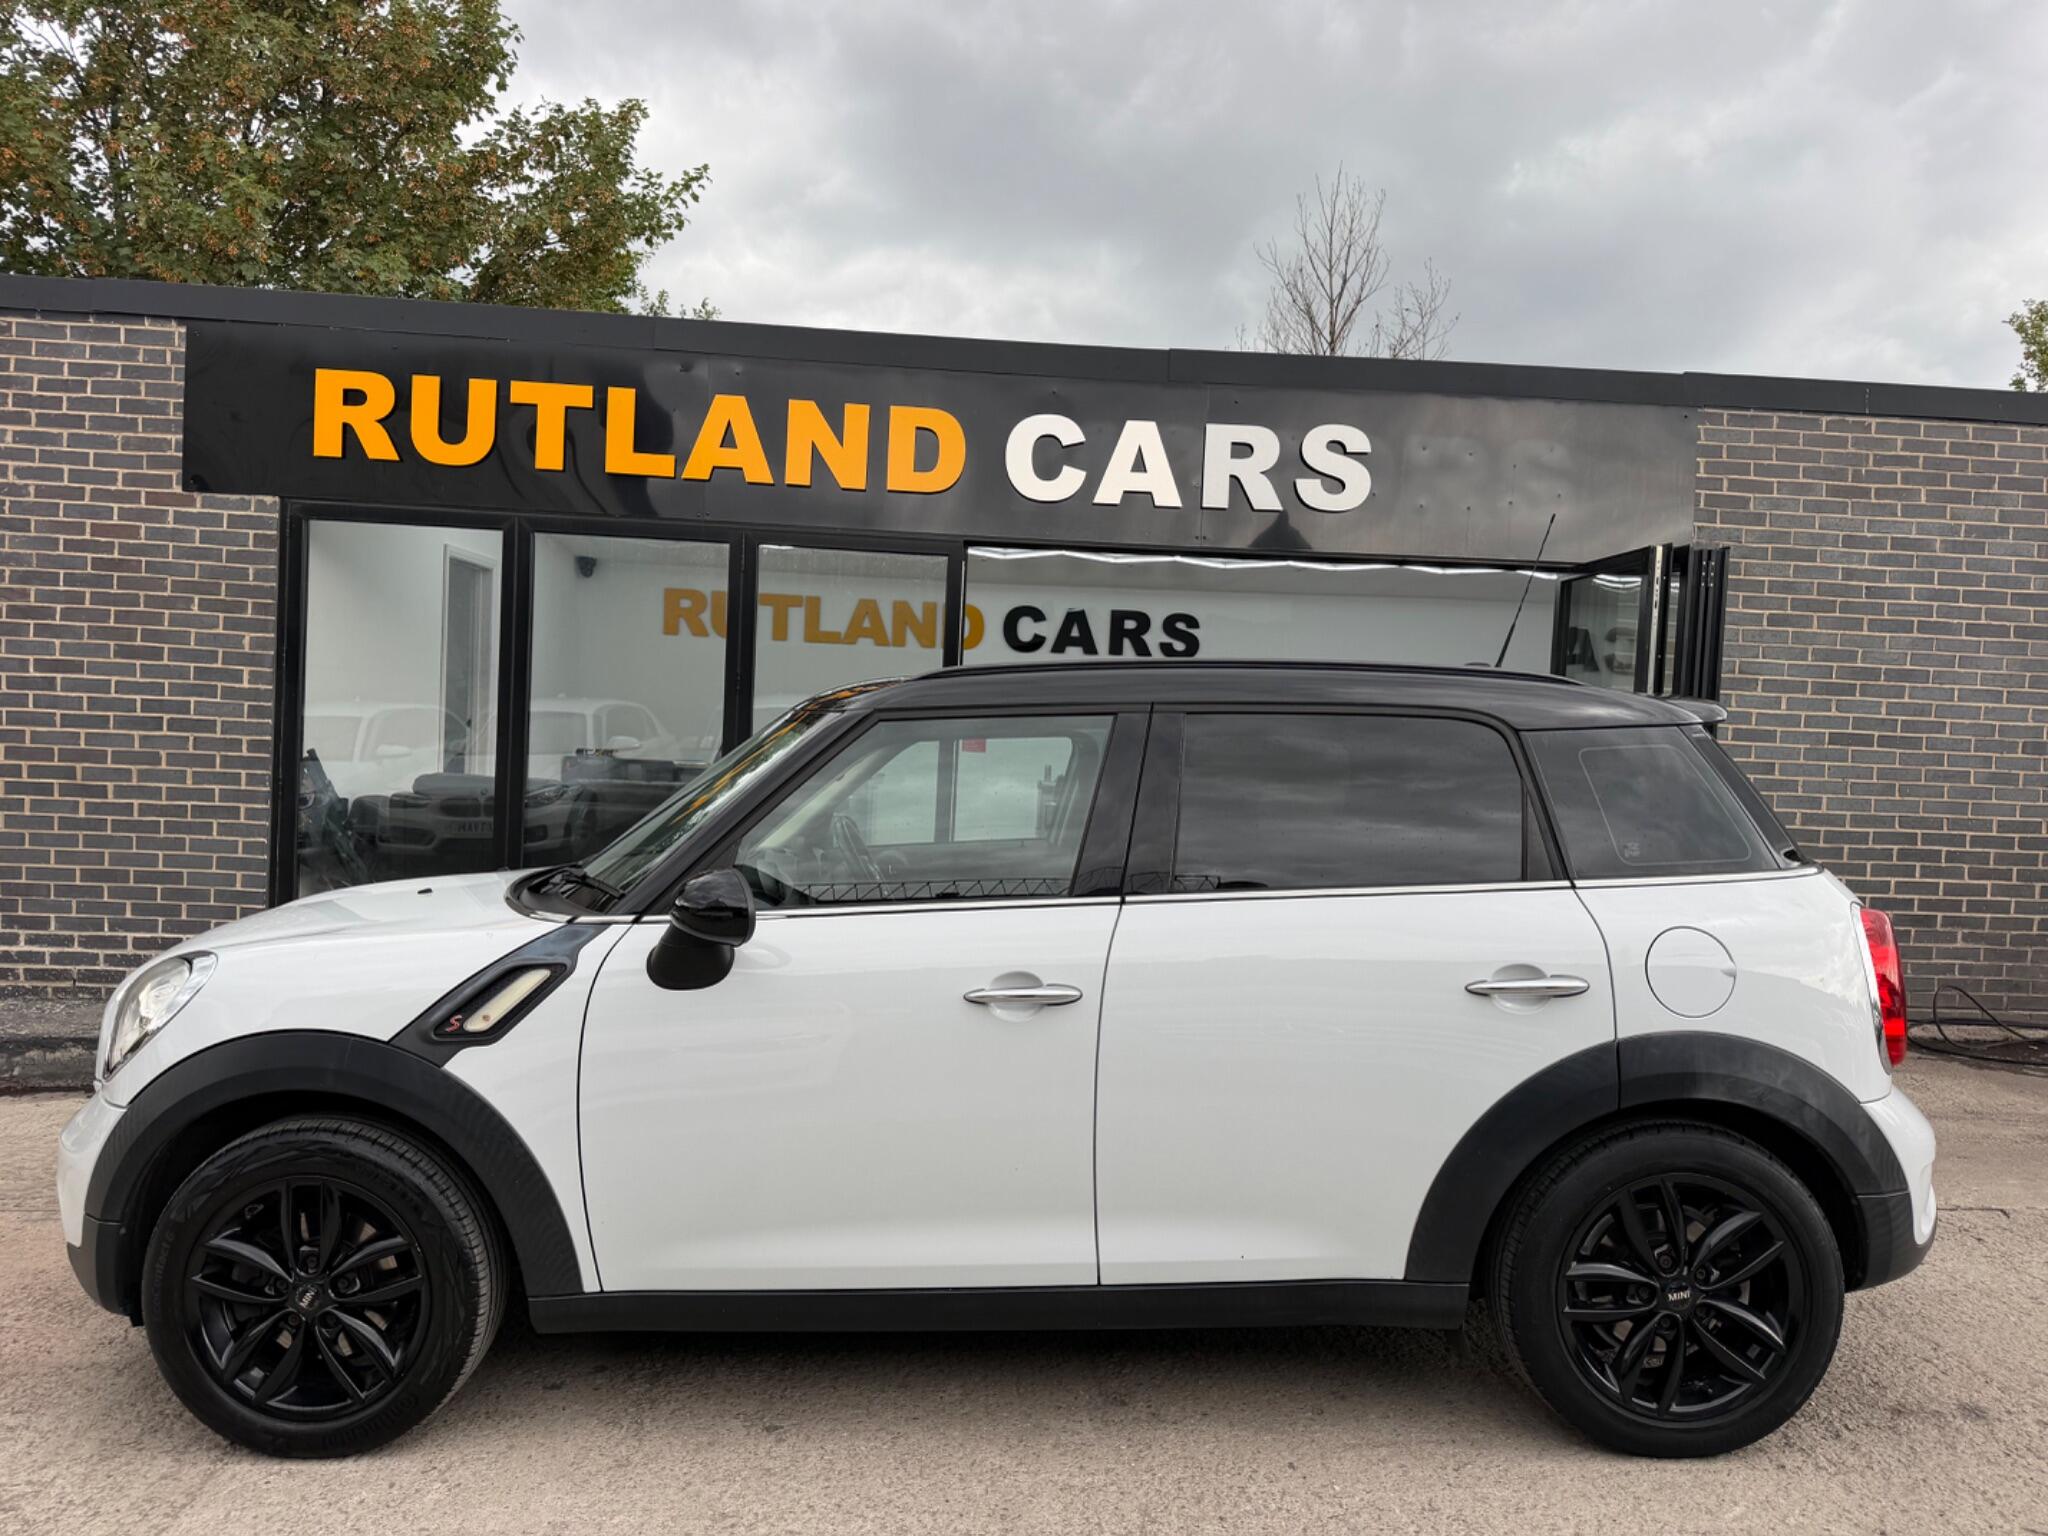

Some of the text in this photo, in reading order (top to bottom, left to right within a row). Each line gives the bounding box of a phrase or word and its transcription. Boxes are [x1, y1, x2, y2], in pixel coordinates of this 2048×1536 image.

[313, 367, 967, 494] RUTLAND
[1004, 413, 1373, 513] CARS
[1002, 604, 1201, 658] CARS
[1667, 1289, 1691, 1302] MINI
